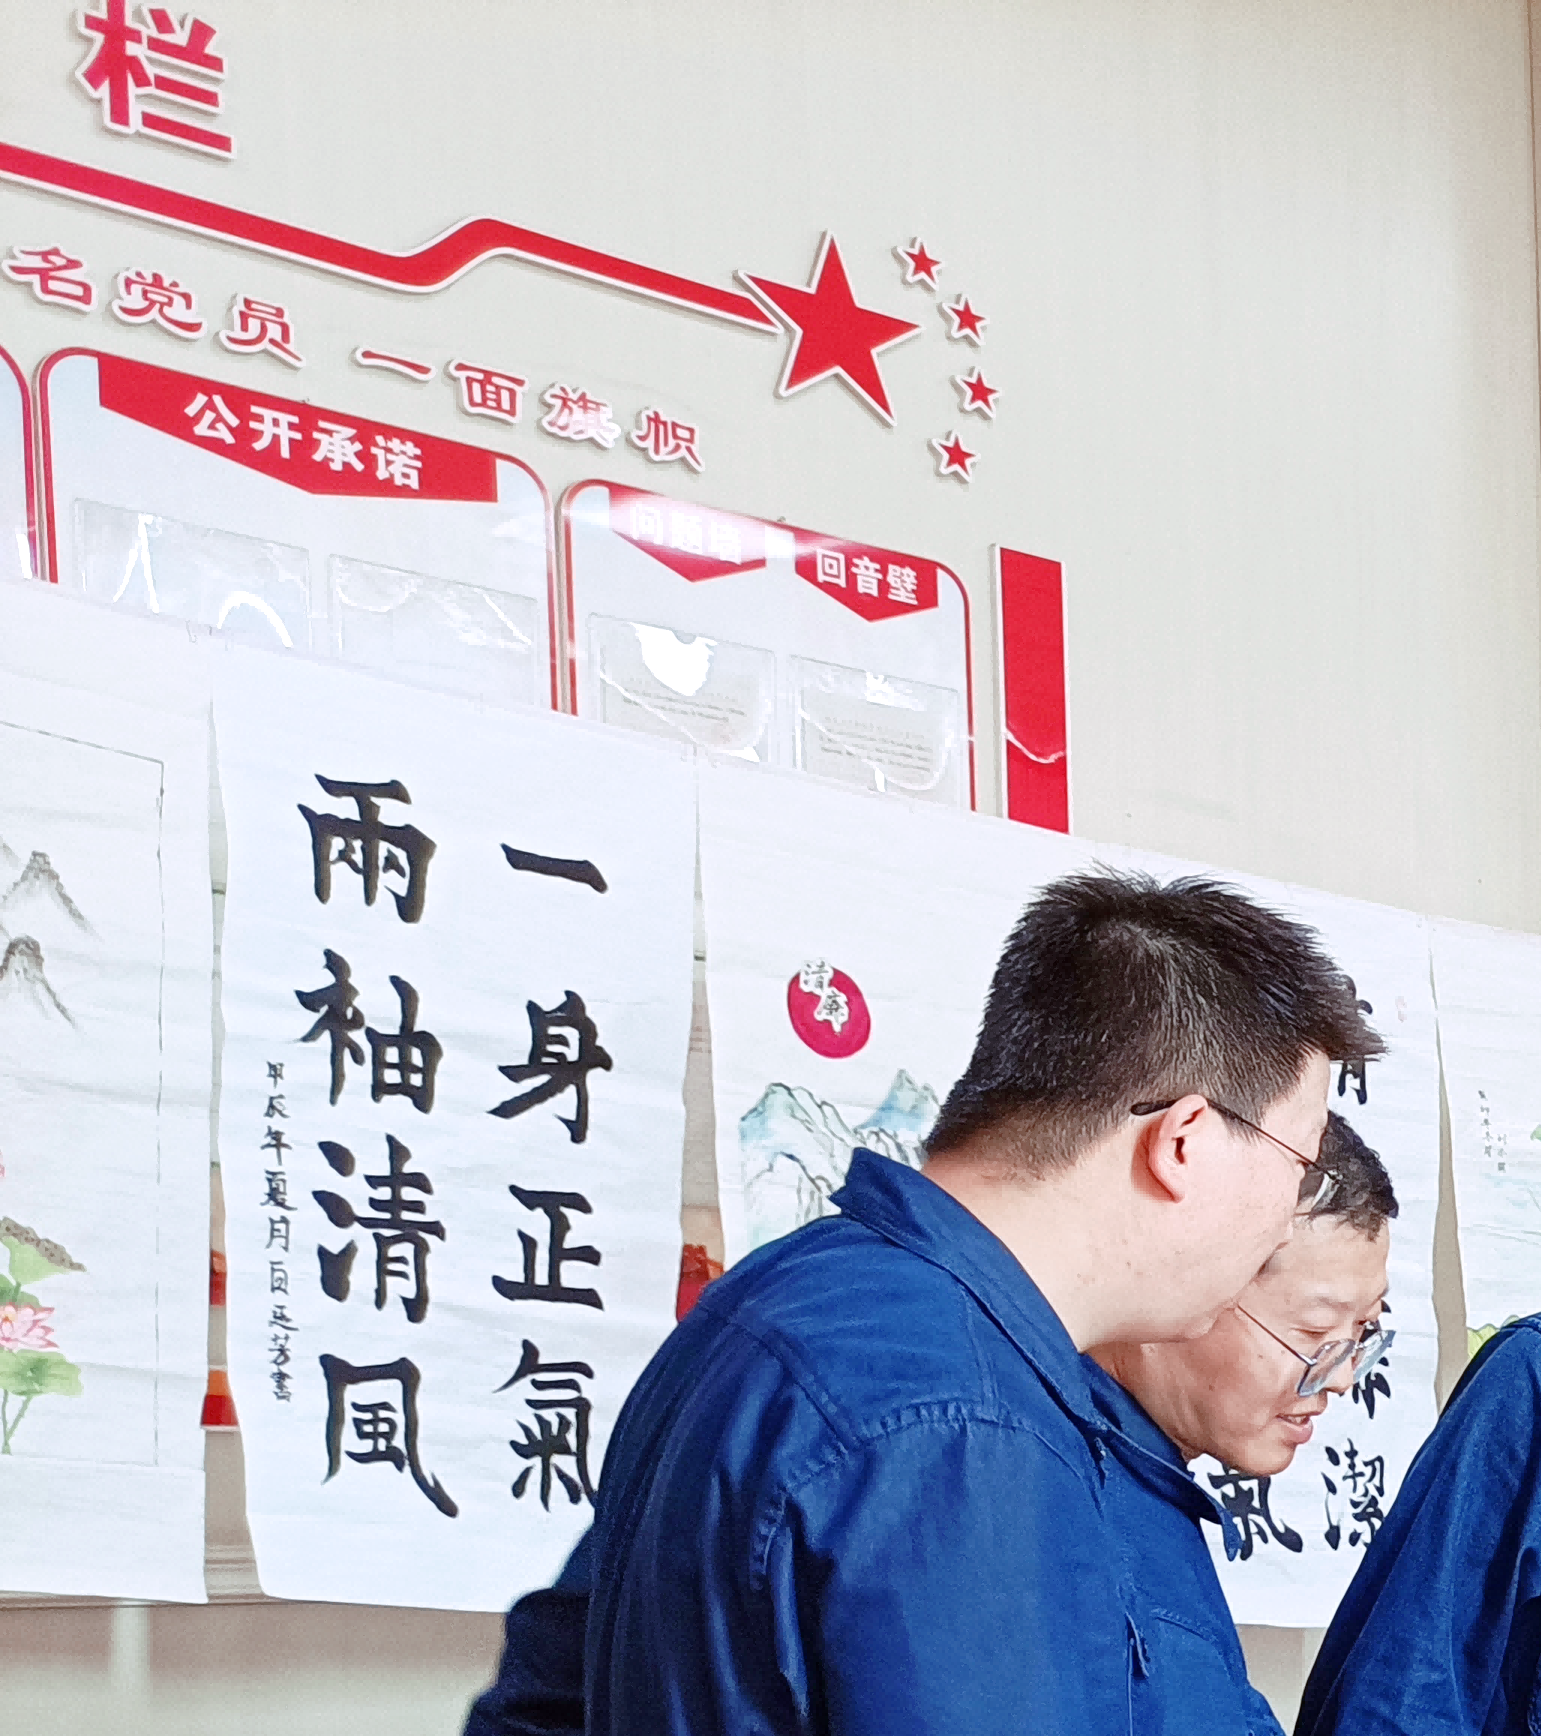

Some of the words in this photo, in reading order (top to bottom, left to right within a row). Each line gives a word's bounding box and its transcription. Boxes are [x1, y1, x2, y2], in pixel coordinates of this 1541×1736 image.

[84, 0, 232, 154] 栏
[8, 247, 303, 363] 名党员
[360, 349, 706, 473] 一面旗帜
[183, 391, 424, 491] 公开承诺
[816, 549, 919, 606] 回音壁
